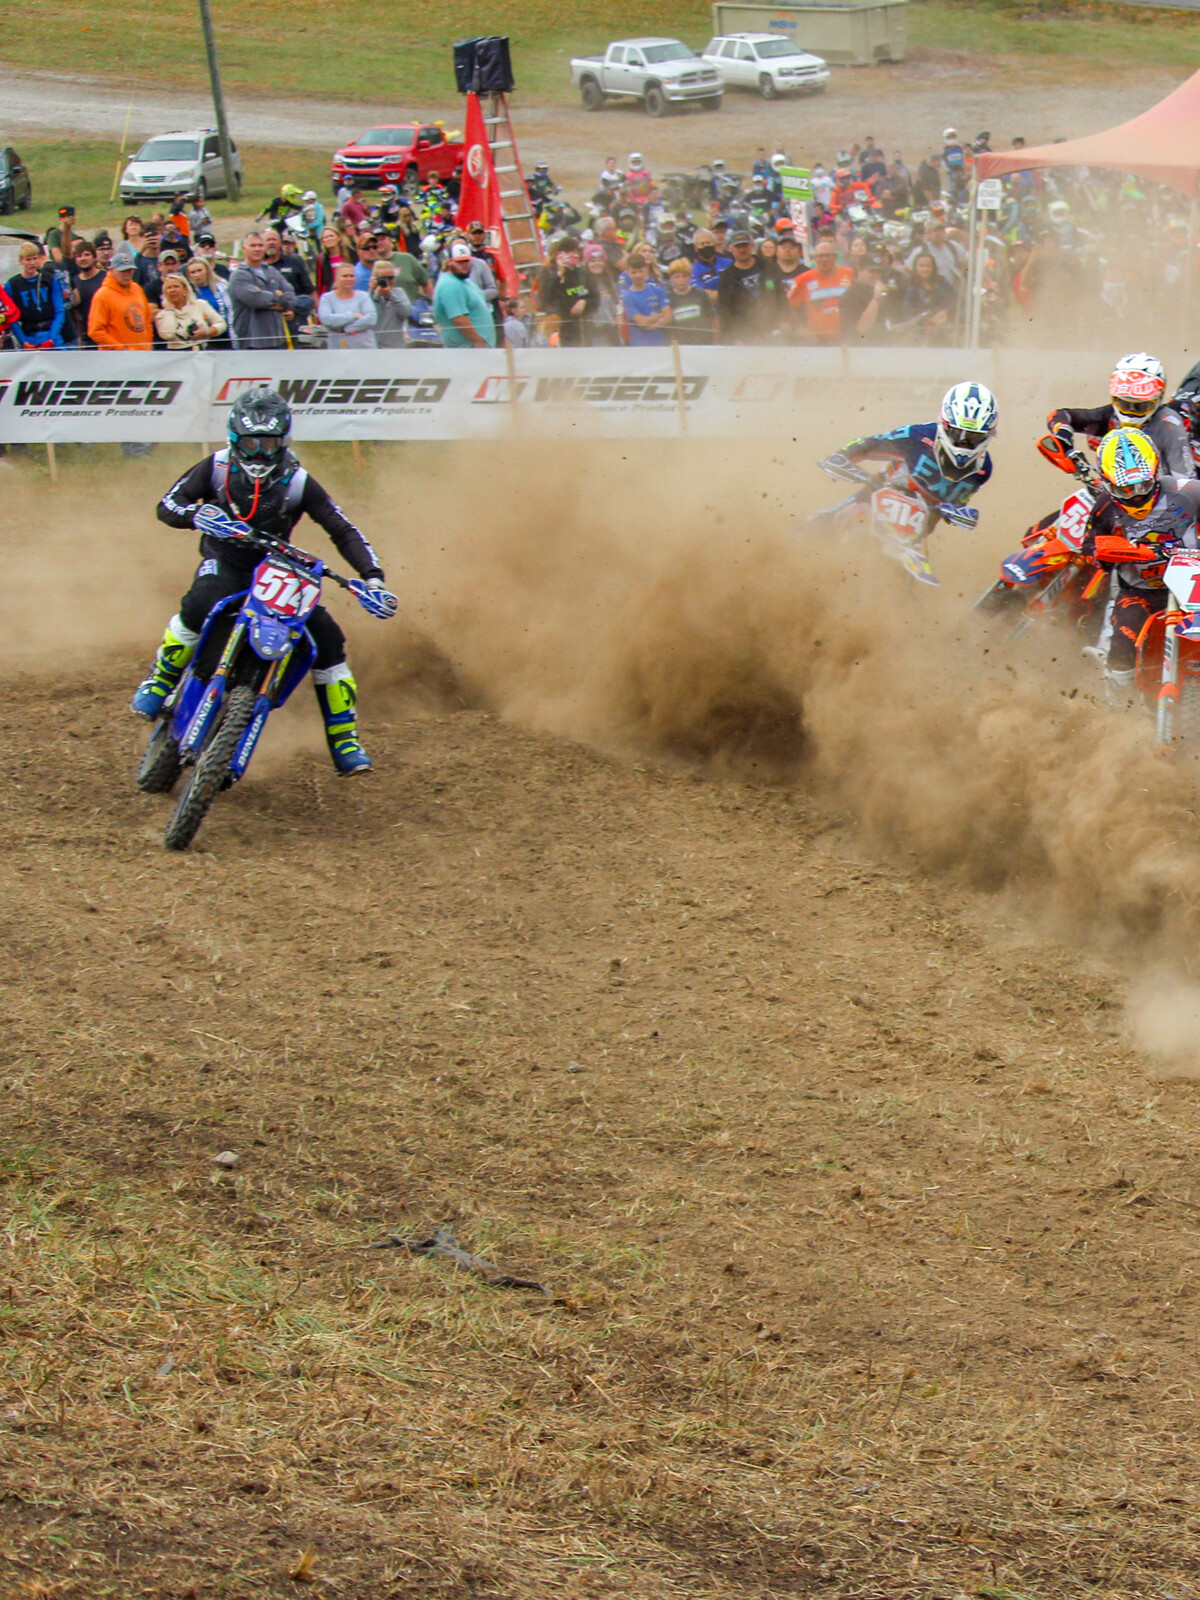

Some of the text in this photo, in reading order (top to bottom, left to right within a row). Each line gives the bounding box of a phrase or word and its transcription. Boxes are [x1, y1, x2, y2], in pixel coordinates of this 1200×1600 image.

[17, 380, 183, 405] WISECO
[533, 375, 710, 402] WISECO
[20, 408, 164, 418] Performance Products
[289, 407, 433, 416] erformance Products
[252, 566, 320, 617] 514
[237, 713, 263, 768] DUNLOP
